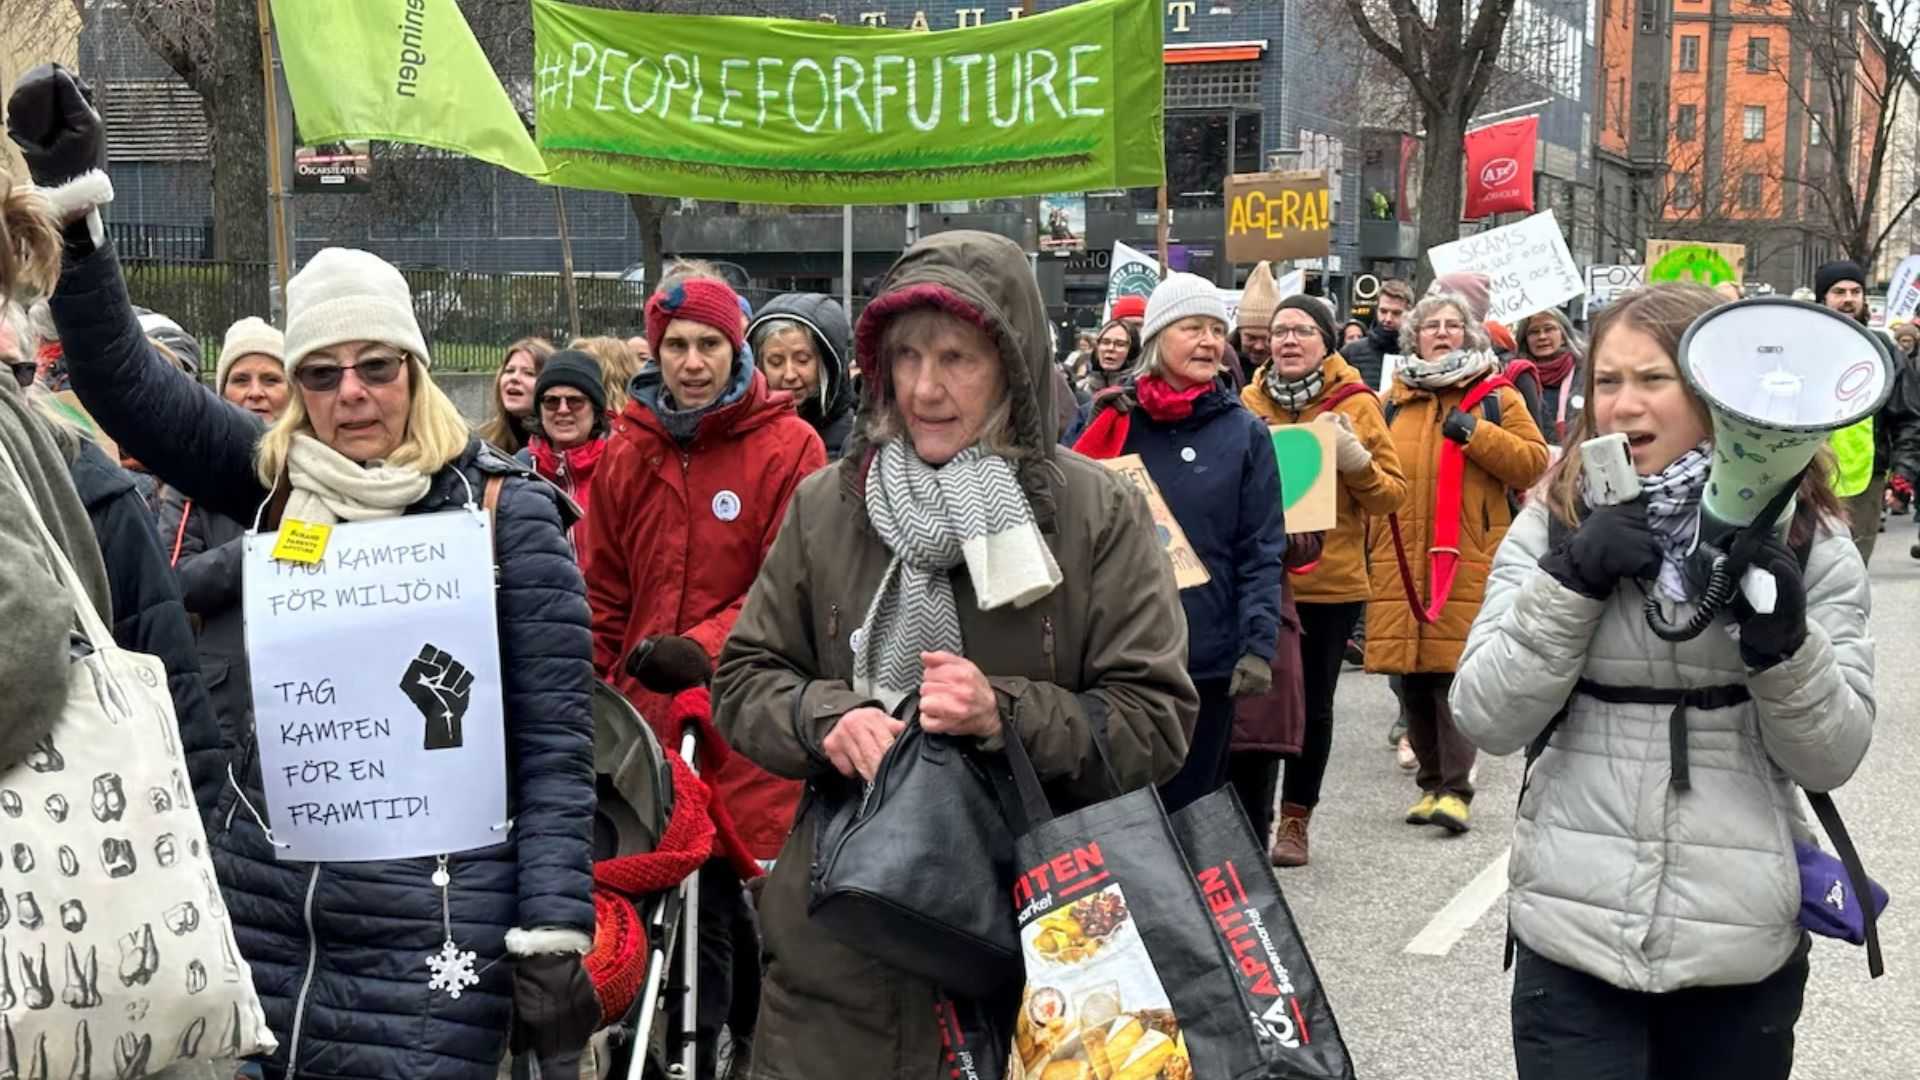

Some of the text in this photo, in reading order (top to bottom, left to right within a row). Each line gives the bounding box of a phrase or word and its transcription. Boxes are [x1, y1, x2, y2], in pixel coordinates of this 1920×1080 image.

[539, 42, 1105, 133] #PEOPLEFORFUTURE
[1228, 189, 1329, 239] AGERA!
[338, 543, 446, 570] KAMPEN
[268, 578, 461, 616] FÖR MILJÖN!
[274, 678, 337, 705] TAG
[280, 718, 392, 746] KAMPEN
[282, 759, 385, 787] FÖR EN
[287, 795, 430, 826] FRAMTID!
[1197, 865, 1282, 997] APTITEN
[1244, 907, 1295, 994] Supermarket
